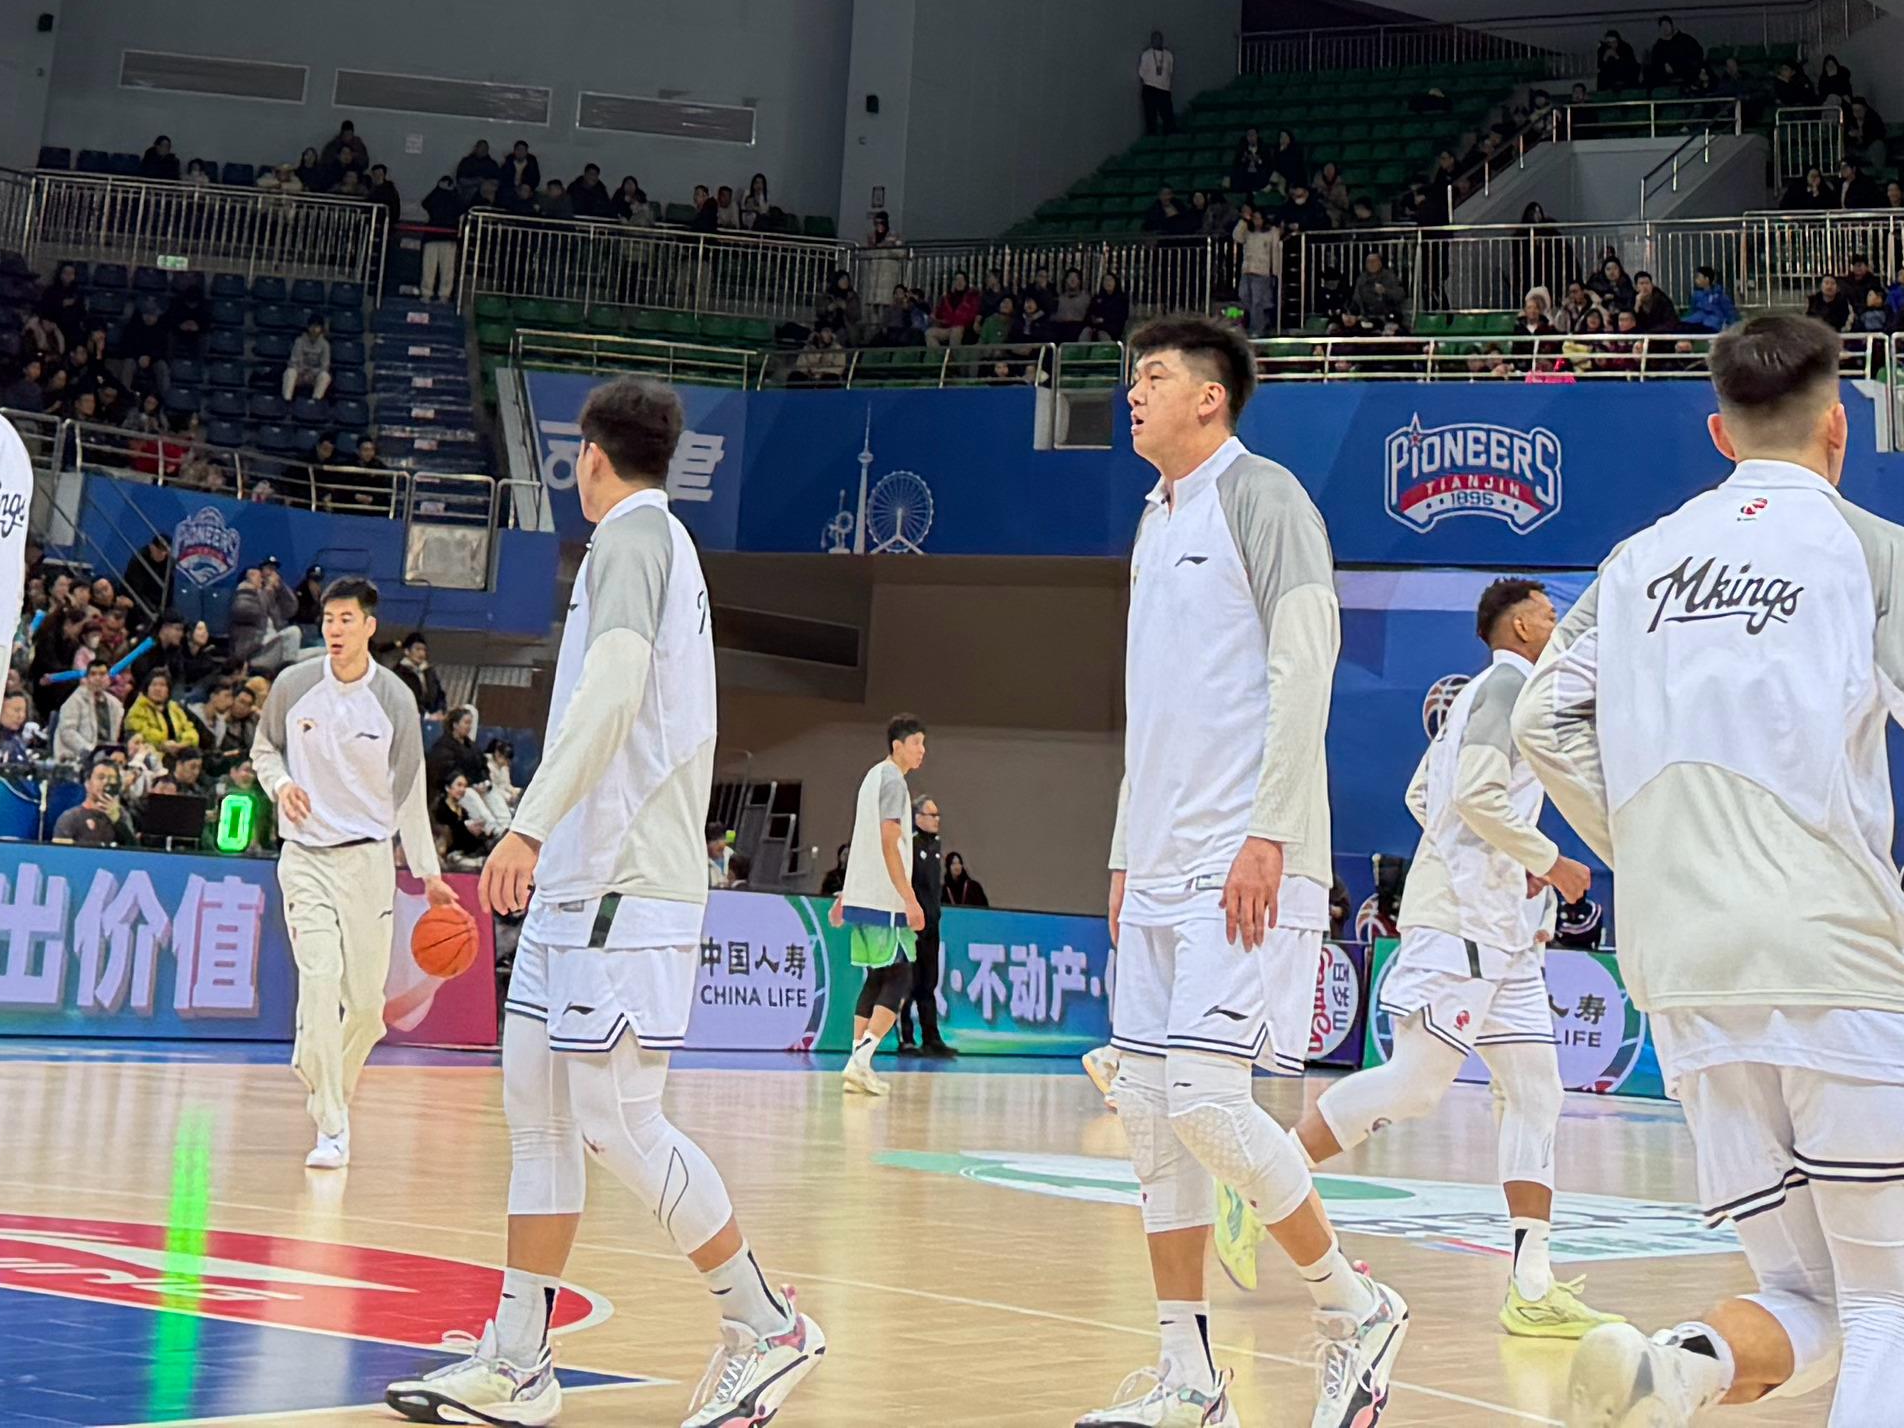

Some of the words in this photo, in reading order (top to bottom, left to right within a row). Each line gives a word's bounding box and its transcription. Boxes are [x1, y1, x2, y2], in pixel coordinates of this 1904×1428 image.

[1391, 430, 1555, 506] PIONEERS
[1426, 475, 1519, 497] TIANJIN
[1647, 556, 1804, 635] Mkings
[217, 795, 253, 852] 0
[701, 938, 807, 982] 中国人寿
[700, 985, 762, 1007] CHINA
[768, 985, 808, 1009] LIFE
